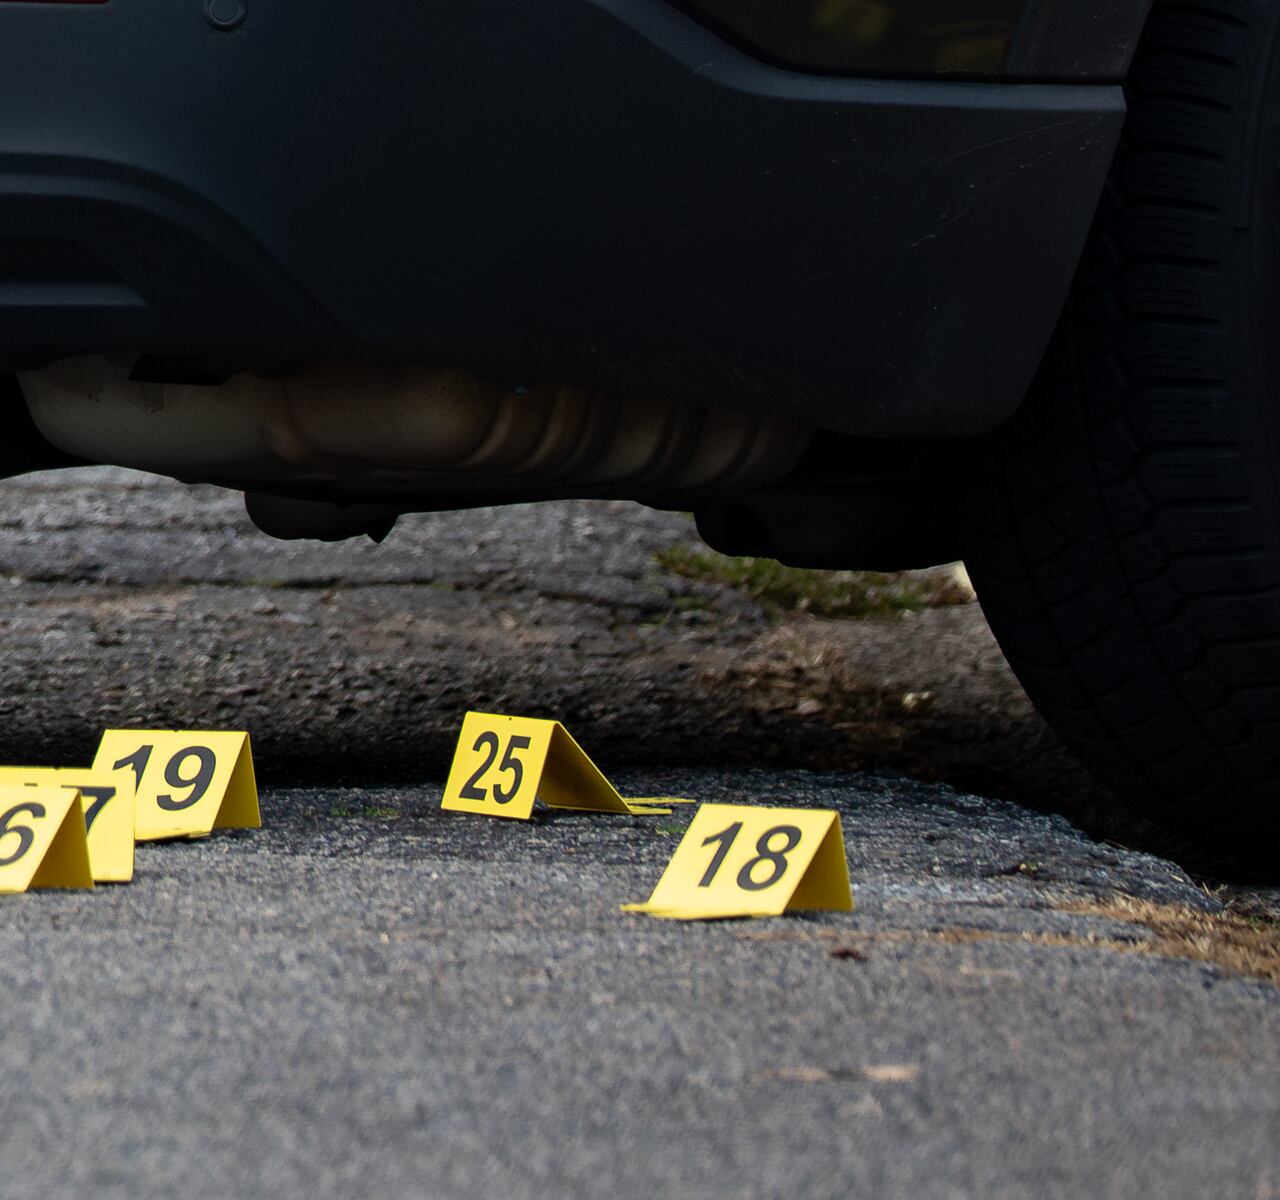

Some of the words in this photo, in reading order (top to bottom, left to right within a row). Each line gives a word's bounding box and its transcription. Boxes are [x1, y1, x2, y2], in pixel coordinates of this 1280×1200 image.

[112, 744, 217, 811] 19
[458, 730, 532, 805] 25
[698, 822, 802, 891] 18
